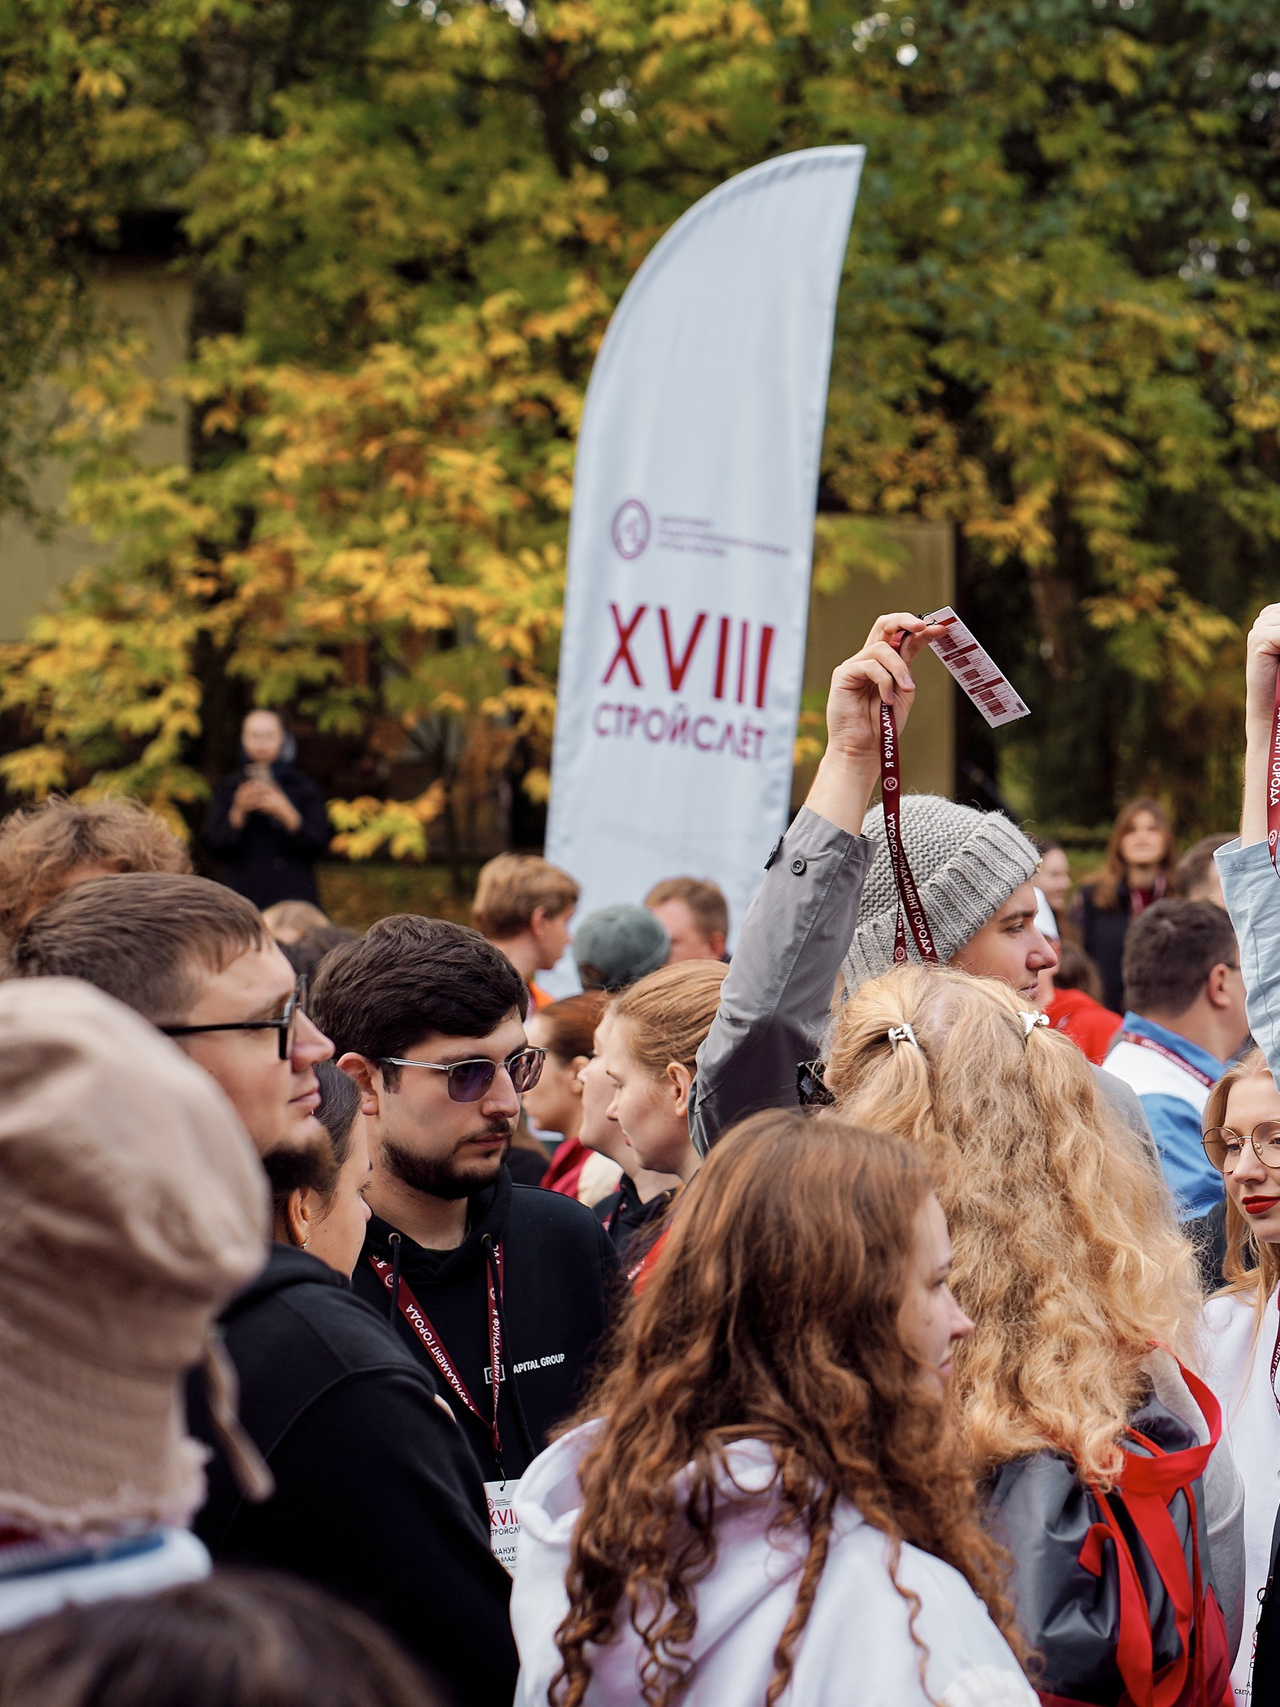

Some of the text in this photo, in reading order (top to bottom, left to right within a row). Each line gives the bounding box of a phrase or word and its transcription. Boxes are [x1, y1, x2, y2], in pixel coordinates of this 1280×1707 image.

[601, 602, 775, 710] XVIII
[887, 813, 898, 857] ГОРОДА
[911, 910, 933, 955] ГОРОДА
[405, 1303, 437, 1352] ГОРОДА
[513, 1353, 565, 1374] APITAL GROUP
